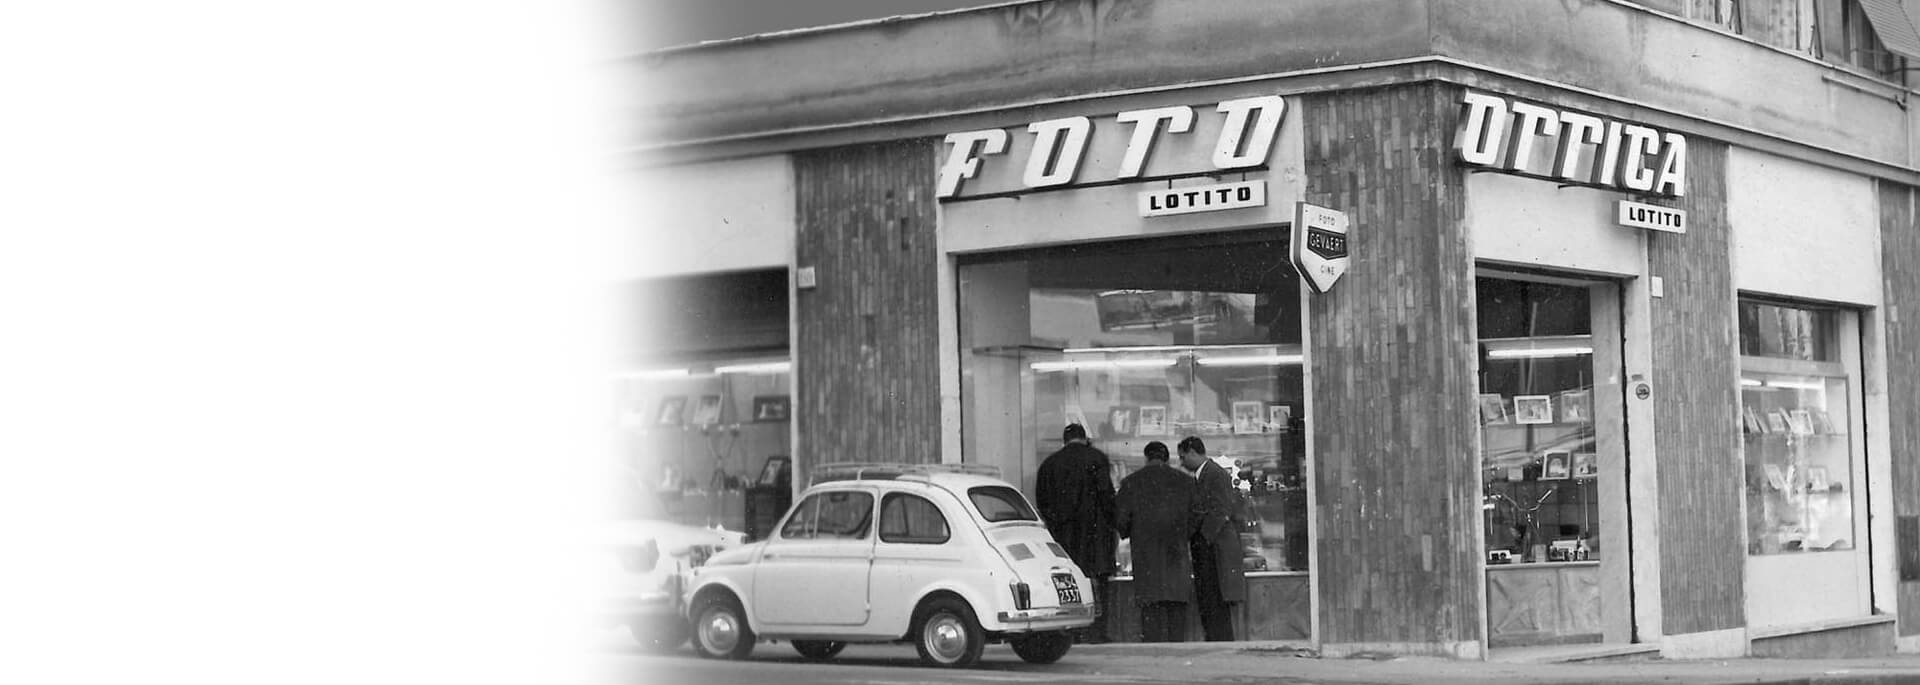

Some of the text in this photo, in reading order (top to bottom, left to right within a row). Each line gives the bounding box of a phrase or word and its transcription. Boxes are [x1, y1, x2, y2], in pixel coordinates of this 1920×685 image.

[935, 95, 1287, 199] FOTO
[1461, 91, 1687, 197] OTTICA
[1150, 187, 1251, 210] LOTITO
[1319, 214, 1336, 226] FOTO
[1629, 207, 1682, 227] LOTITO
[1310, 233, 1345, 252] GEVAERT
[1320, 265, 1335, 276] CINE
